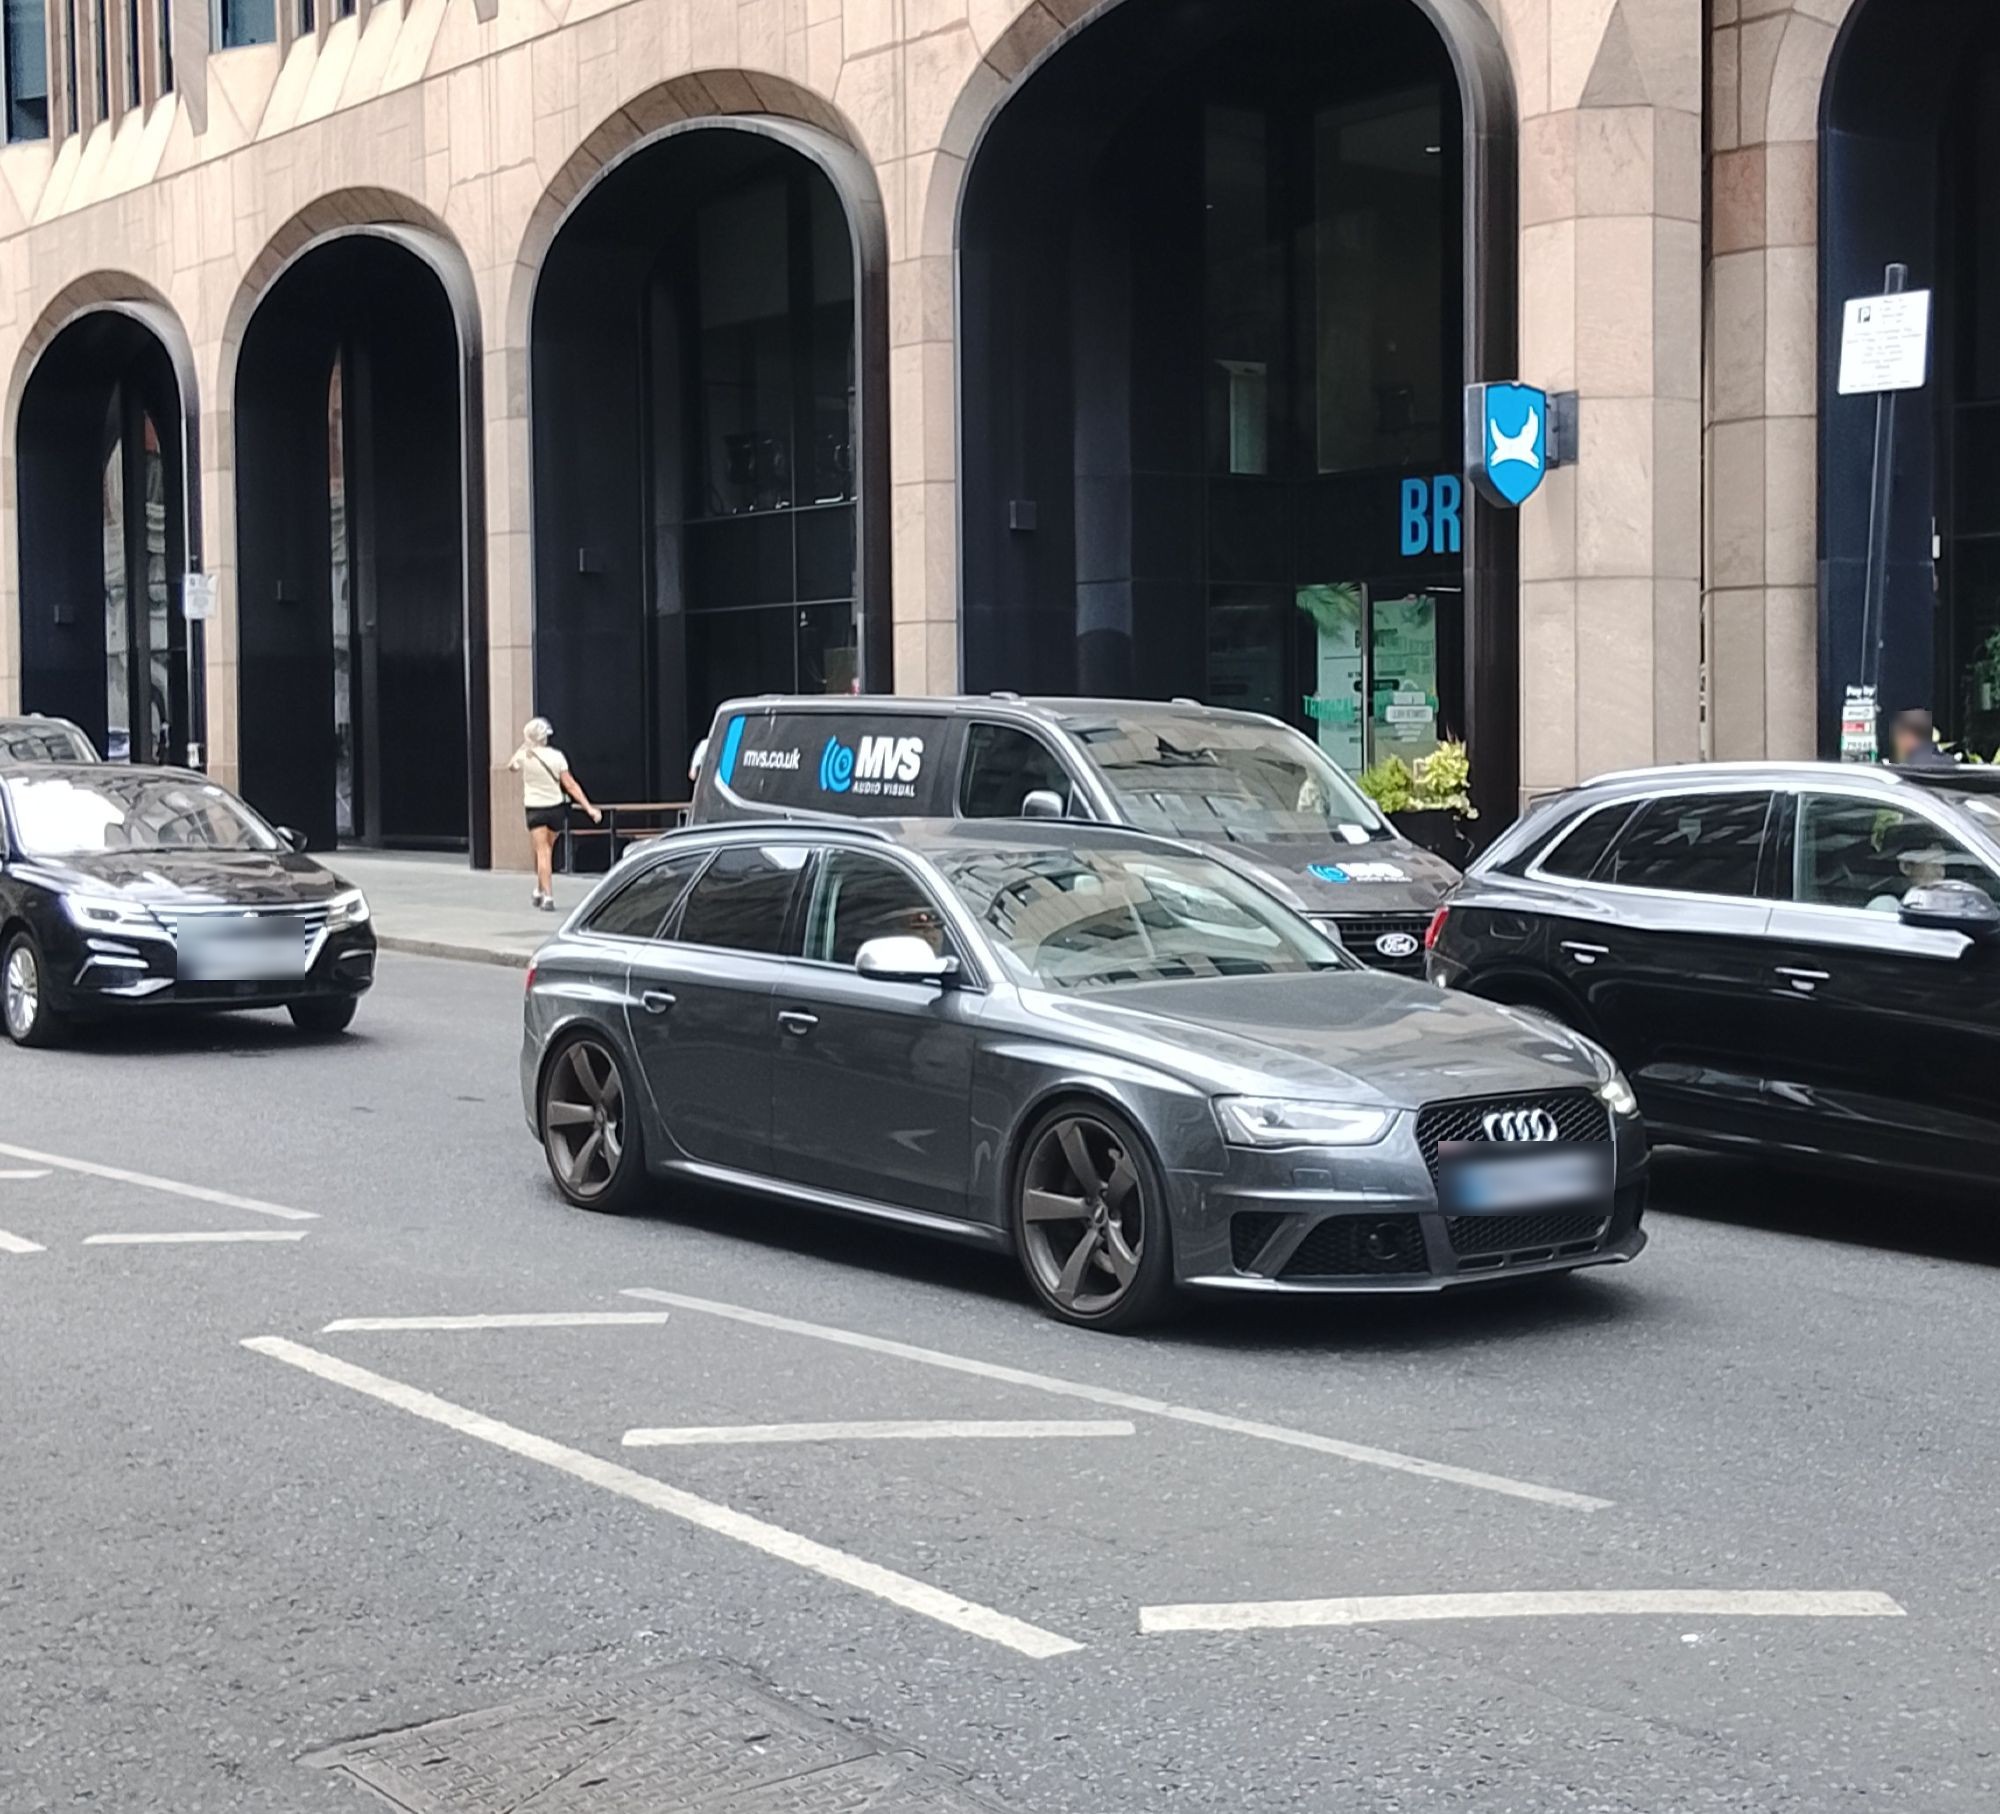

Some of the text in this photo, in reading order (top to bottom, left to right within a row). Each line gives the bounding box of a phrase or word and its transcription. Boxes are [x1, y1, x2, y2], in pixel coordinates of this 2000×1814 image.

[1401, 475, 1461, 556] BR
[743, 748, 800, 770] mvs.co.uk
[855, 736, 923, 782] MVS
[852, 780, 915, 798] AUDIO VISUAL
[1382, 936, 1413, 954] Ford
